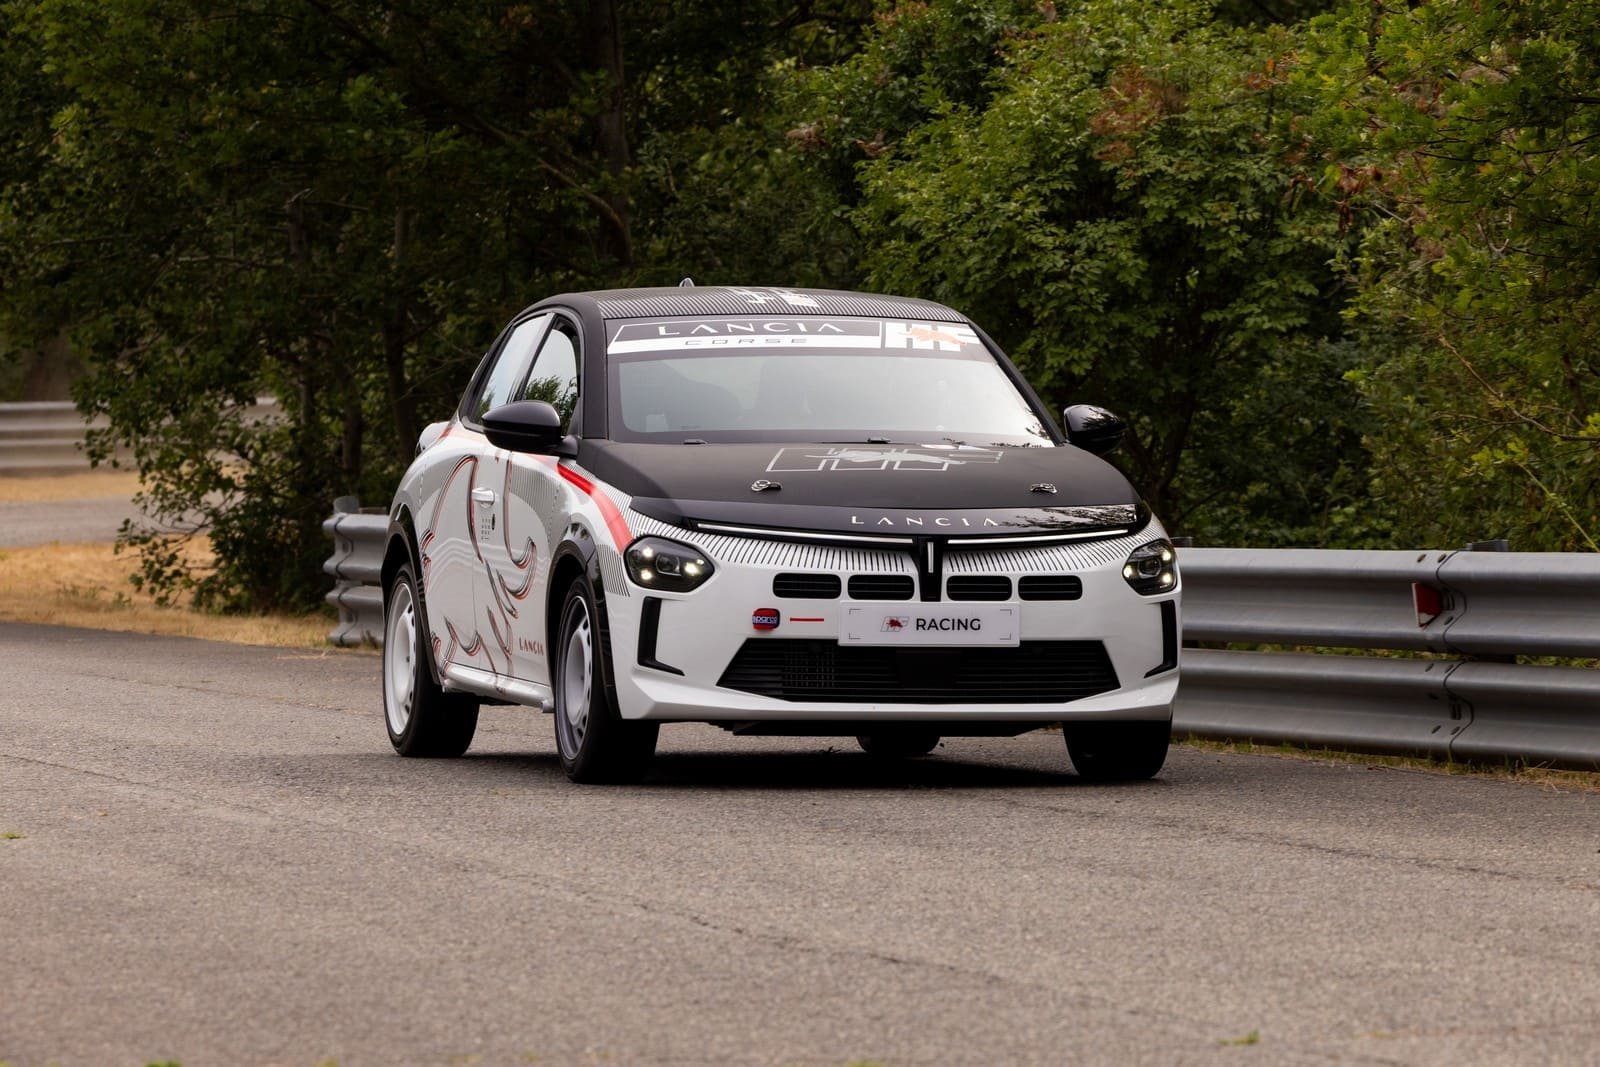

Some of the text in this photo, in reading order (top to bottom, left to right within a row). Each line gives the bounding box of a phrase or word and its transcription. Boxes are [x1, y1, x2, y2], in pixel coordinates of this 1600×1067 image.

[658, 322, 845, 336] LANCIA
[685, 338, 807, 346] CORSE
[851, 516, 999, 527] LANCIA
[916, 618, 981, 631] RACING
[519, 636, 544, 656] LANCIA
